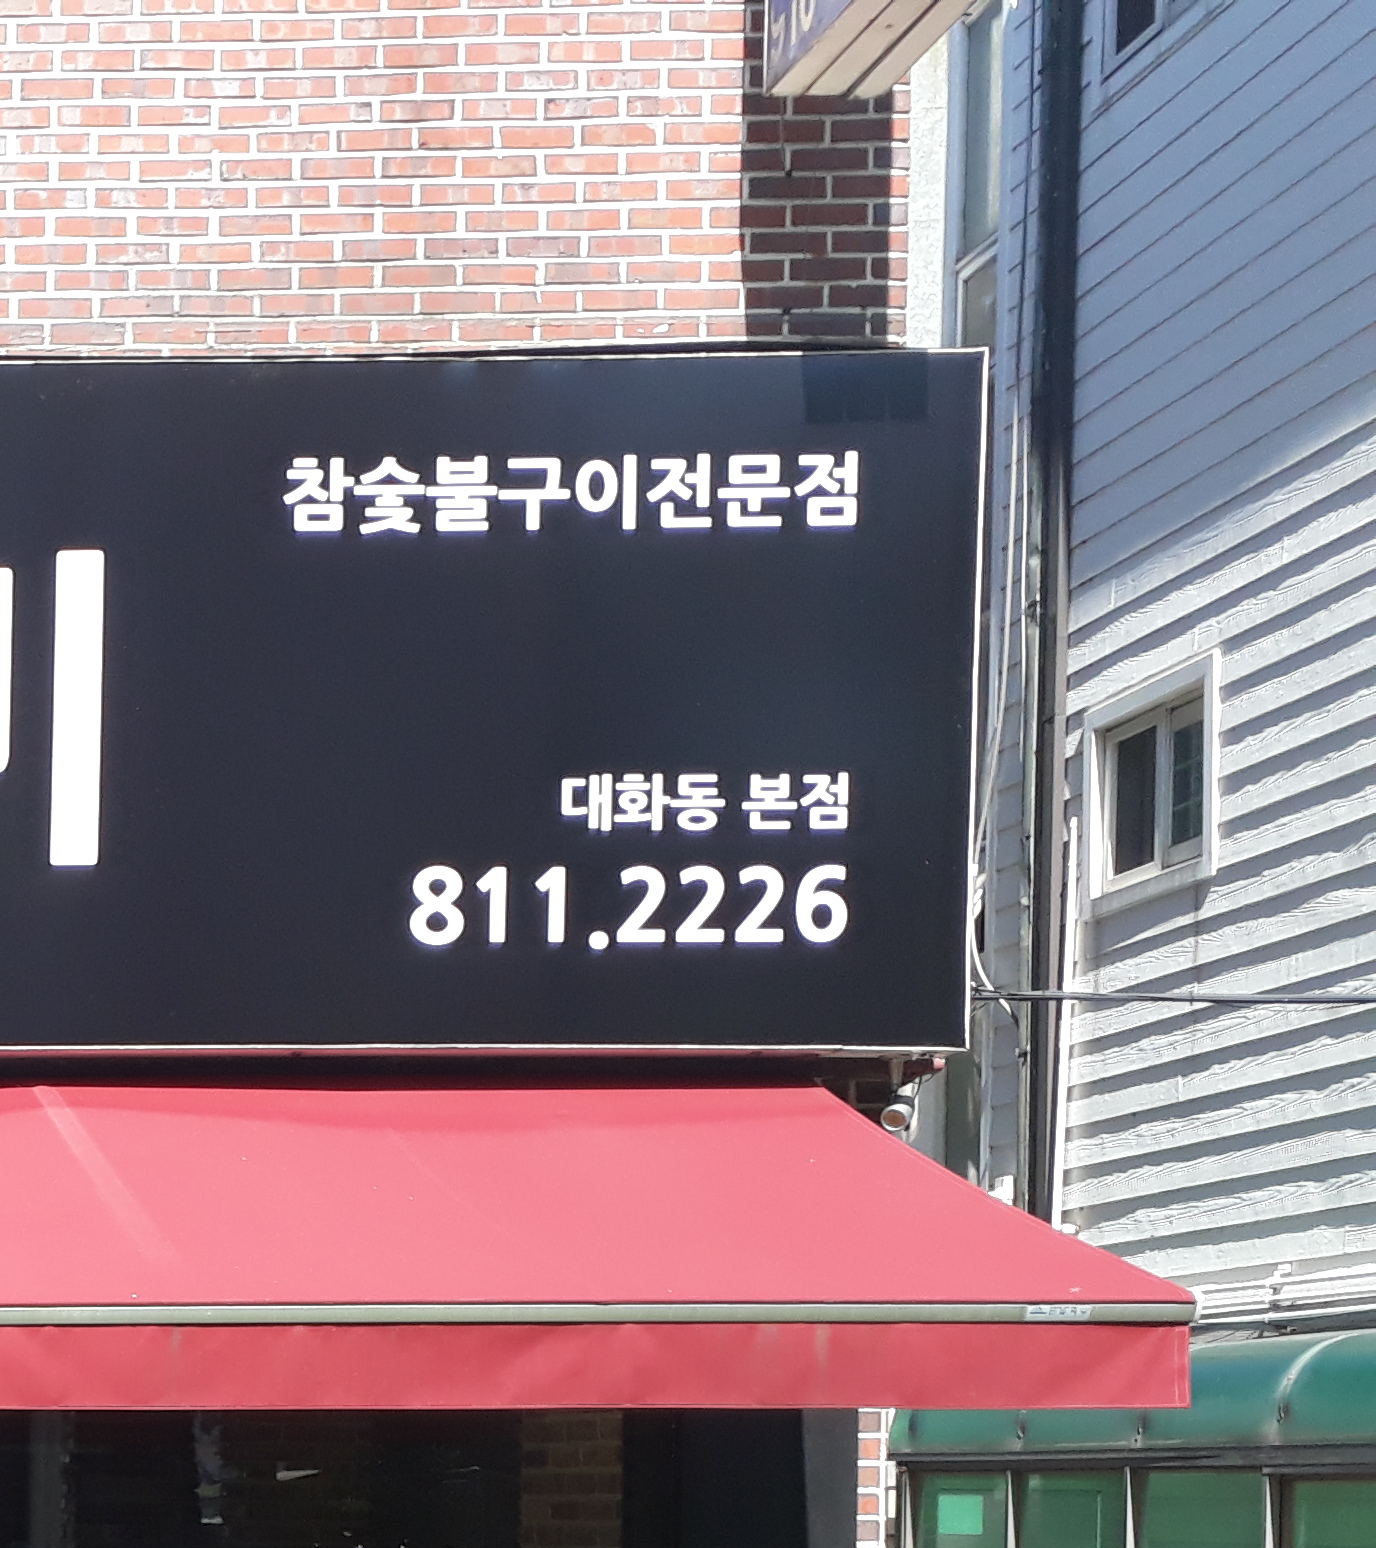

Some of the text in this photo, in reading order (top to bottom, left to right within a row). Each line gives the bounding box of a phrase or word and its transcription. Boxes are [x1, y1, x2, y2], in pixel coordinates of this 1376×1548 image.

[283, 451, 859, 534] 참숯불구이전문점
[561, 772, 849, 831] 대화동 본점
[410, 865, 847, 949] 811.2226
